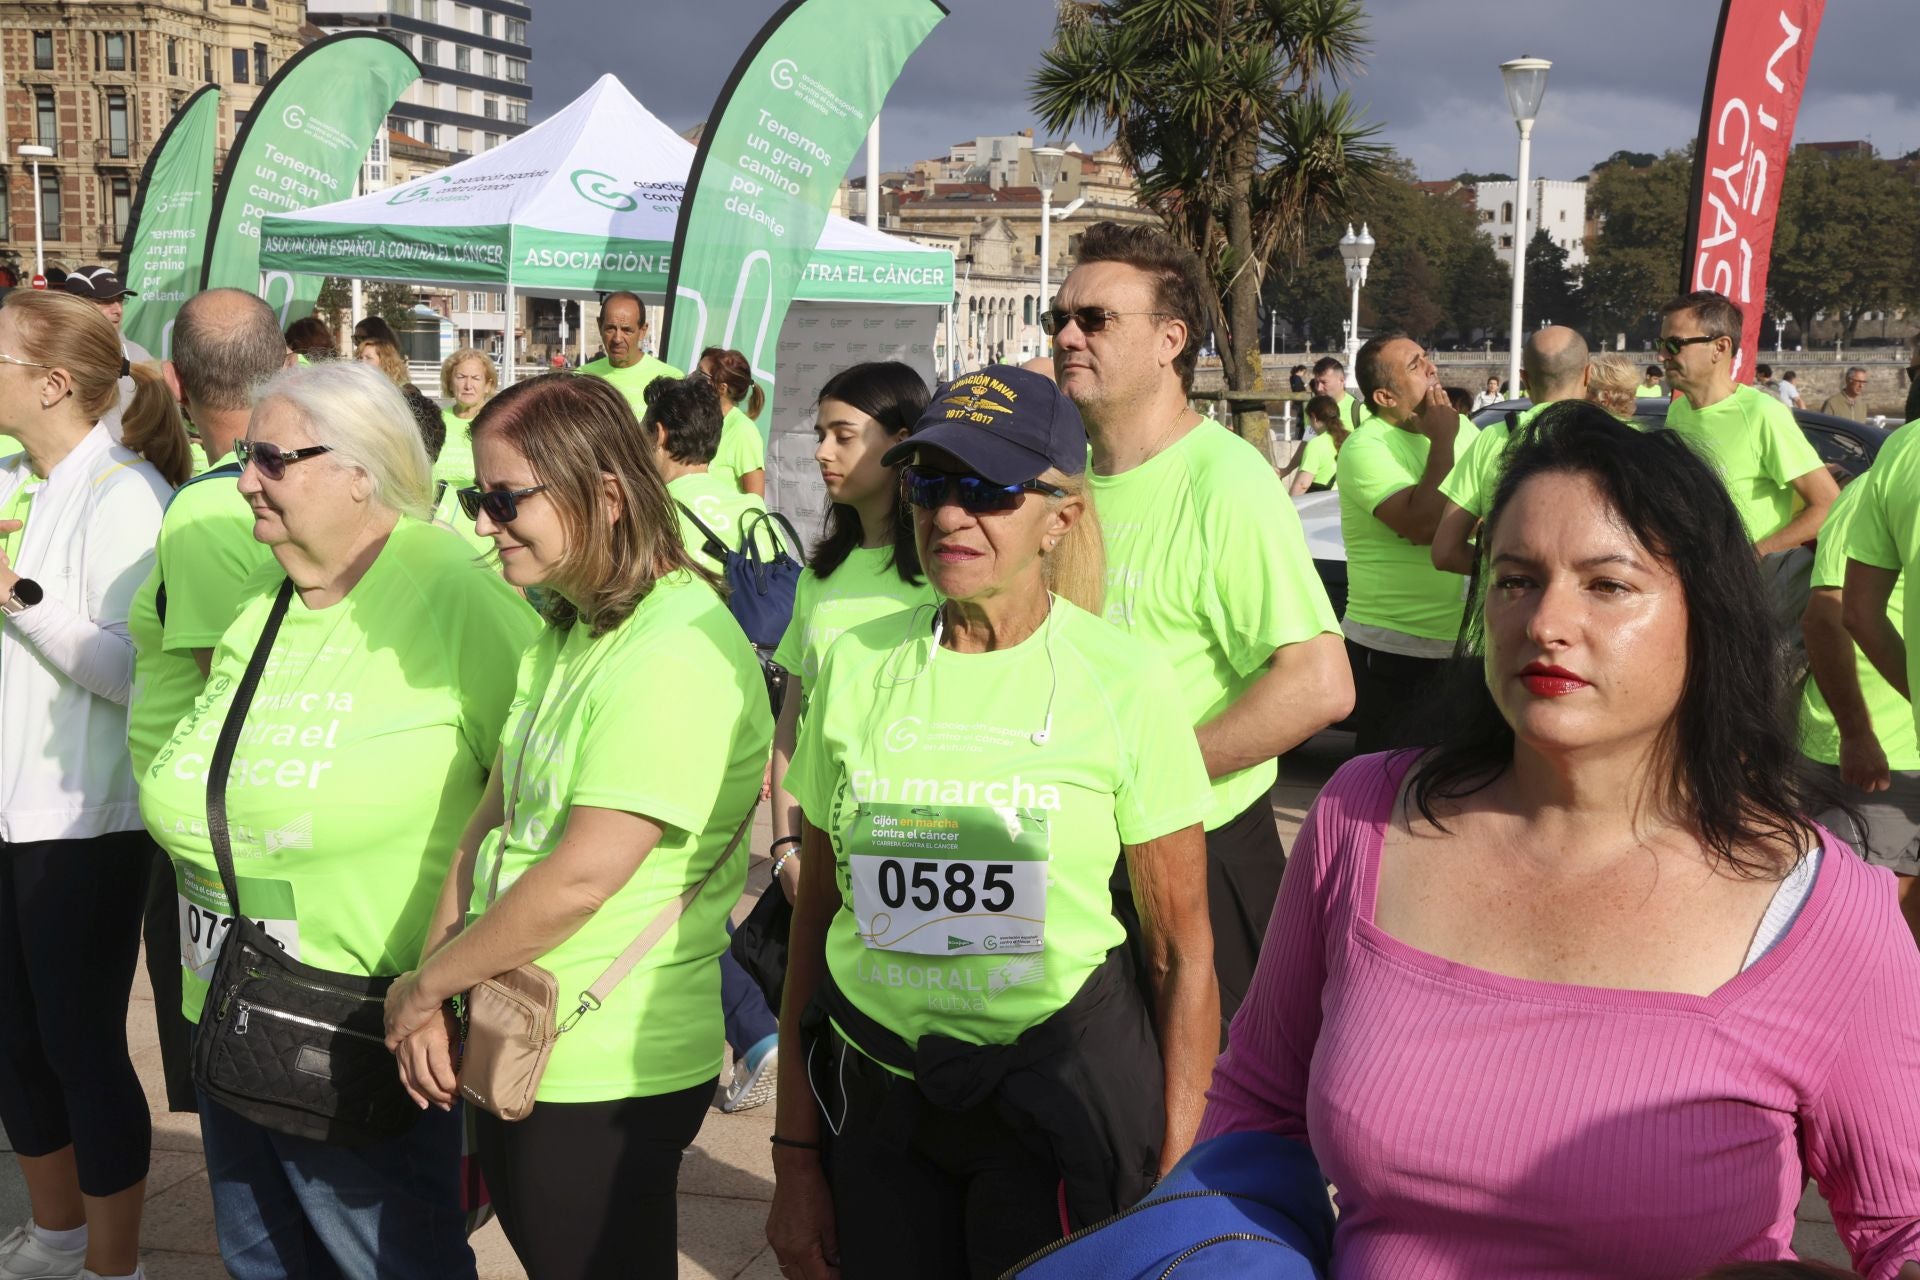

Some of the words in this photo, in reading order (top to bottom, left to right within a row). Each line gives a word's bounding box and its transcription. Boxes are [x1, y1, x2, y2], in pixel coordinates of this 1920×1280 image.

[747, 133, 770, 153] un
[770, 146, 813, 177] gran
[758, 109, 832, 166] Tenemos
[255, 165, 277, 186] un
[279, 175, 321, 200] gran
[263, 144, 339, 189] Tenemos
[738, 154, 801, 196] camino
[634, 181, 686, 191] asocia
[730, 175, 764, 197] por
[1696, 97, 1750, 298] CYAS
[724, 196, 785, 238] delante
[265, 234, 328, 254] ASOCIACIÓN
[329, 235, 385, 257] ESPAÑOLA
[388, 241, 436, 260] CONTRA
[436, 244, 450, 261] EL
[455, 242, 503, 263] CÁNCER
[524, 248, 653, 272] ASOCIACIÓN
[848, 265, 868, 283] EL
[873, 263, 944, 285] CÁNCER
[990, 378, 1019, 403] NAVAL
[850, 770, 890, 802] En
[899, 776, 1062, 811] marcha
[872, 828, 905, 839] contra
[907, 829, 917, 839] el
[920, 830, 959, 841] cáncer
[873, 815, 898, 827] Gijón
[900, 818, 913, 826] en
[916, 818, 959, 828] marcha
[878, 859, 1015, 913] 0585
[857, 957, 983, 991] LABORAL
[928, 993, 985, 1011] kutxa
